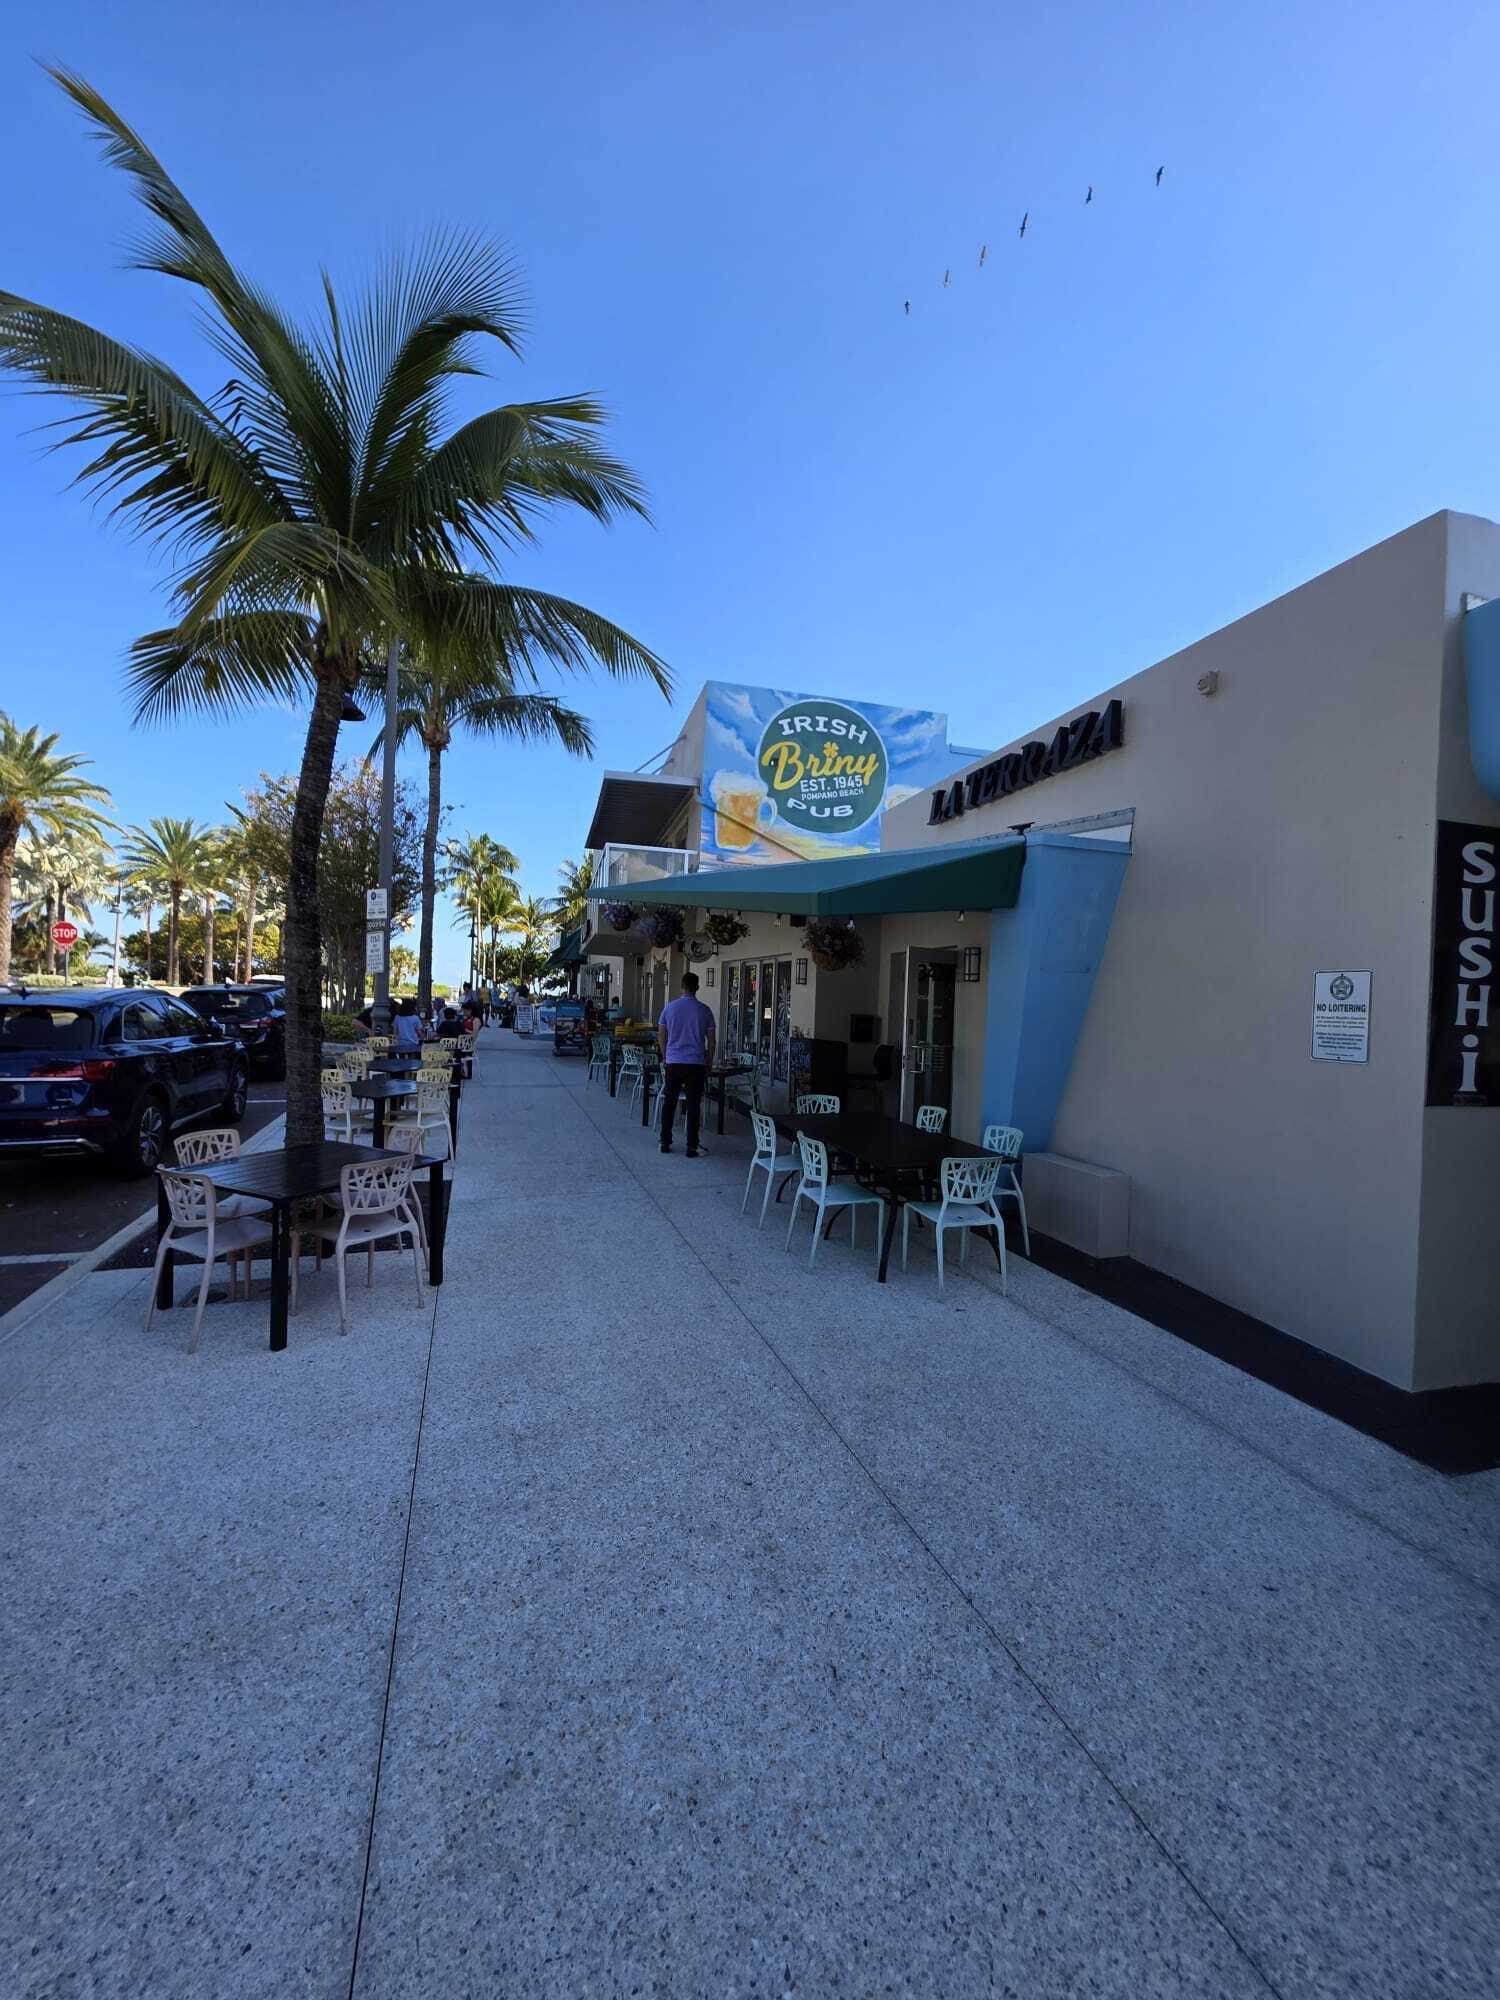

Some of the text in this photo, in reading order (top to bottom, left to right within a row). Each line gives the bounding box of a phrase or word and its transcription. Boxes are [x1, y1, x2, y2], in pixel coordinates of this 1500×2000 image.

[778, 715, 868, 745] IRISH
[761, 741, 880, 791] Briny
[927, 699, 1123, 826] LA TERRAZA
[800, 774, 863, 793] EST. 1945
[801, 787, 865, 801] POMPANO BEACH
[786, 797, 854, 818] PUB
[52, 927, 77, 939] STOP
[1316, 1003, 1367, 1013] NO LOITERING
